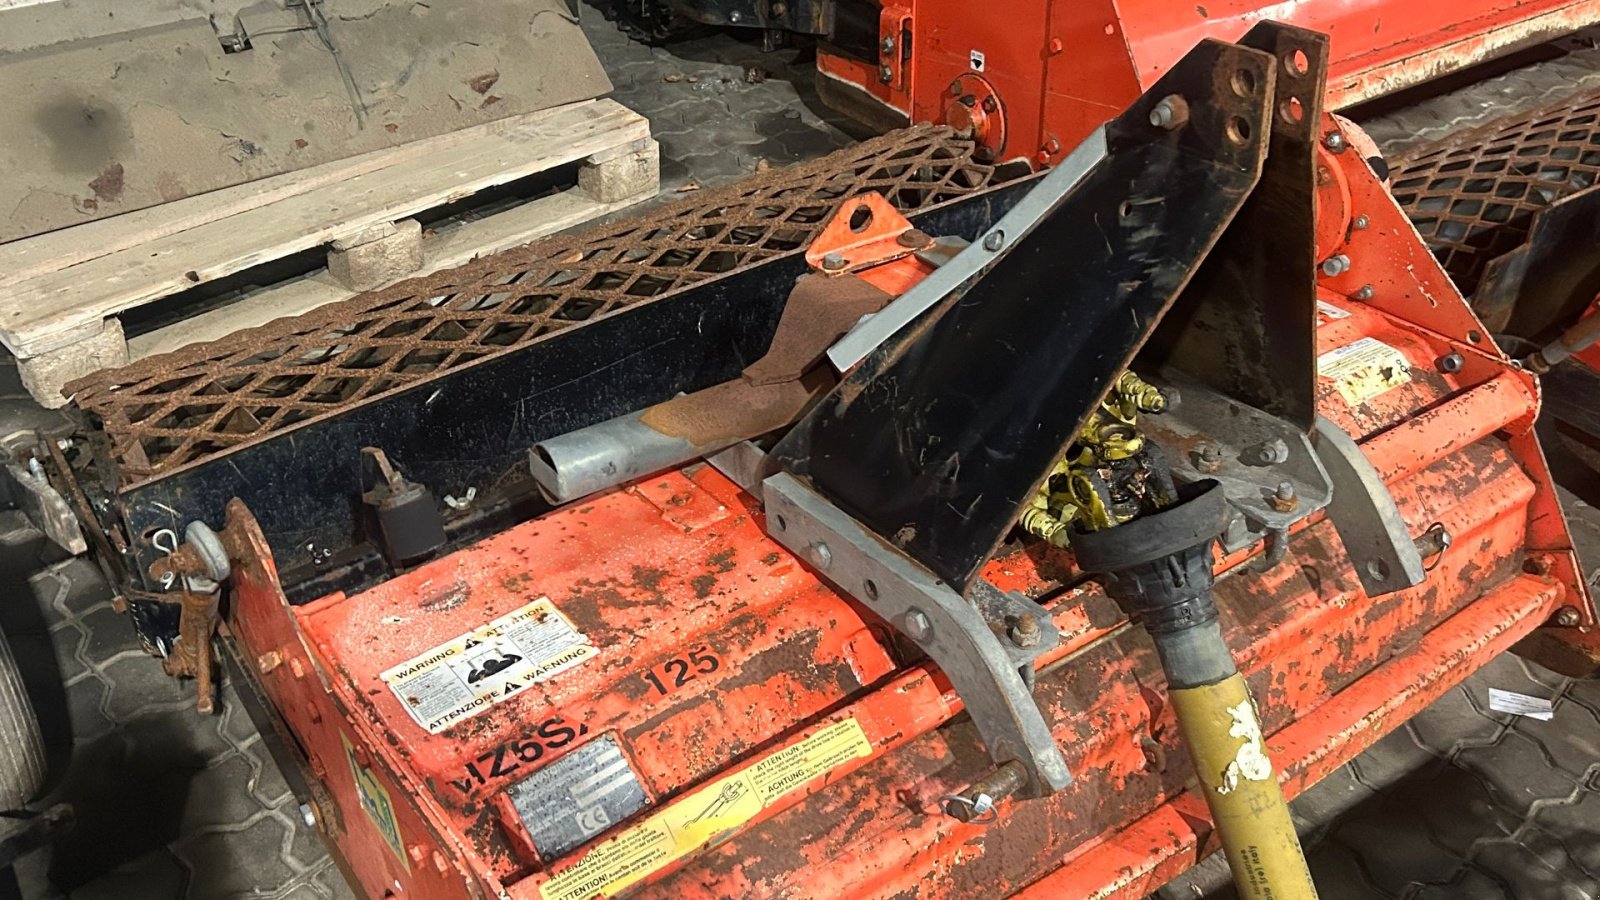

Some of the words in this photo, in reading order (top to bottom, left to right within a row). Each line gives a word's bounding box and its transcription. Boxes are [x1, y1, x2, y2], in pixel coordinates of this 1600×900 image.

[395, 647, 457, 680] WARNING
[645, 646, 720, 696] 125
[428, 690, 501, 732] ATTENZIONE
[522, 647, 588, 682] WARNUNG
